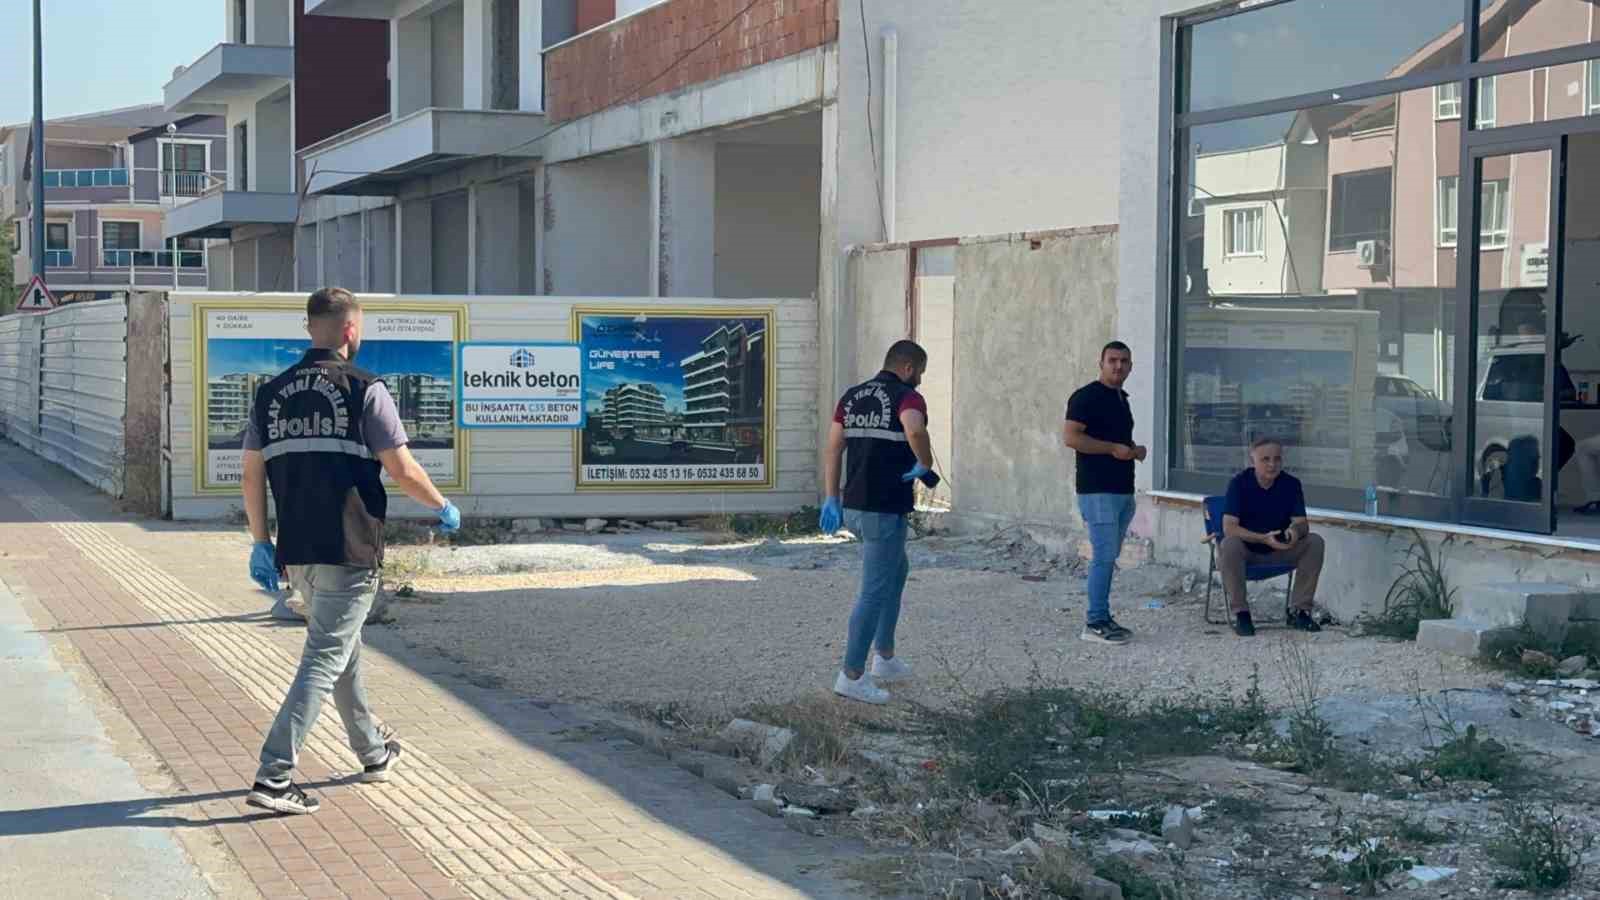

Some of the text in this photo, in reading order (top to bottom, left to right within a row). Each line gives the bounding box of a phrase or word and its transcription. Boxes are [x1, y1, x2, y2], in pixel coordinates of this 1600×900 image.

[589, 347, 661, 361] GÜNEŞTEPE
[463, 370, 580, 388] teknik beton
[465, 403, 478, 412] BU
[480, 402, 526, 413] İNŞAATTA
[547, 403, 579, 412] BETON
[278, 411, 333, 438] POLİS
[476, 414, 569, 423] KULLANILMAKTADIR
[848, 411, 881, 427] POLİS
[587, 467, 628, 480] İLETİŞİM:
[630, 468, 651, 479] 0532
[652, 468, 668, 479] 435
[670, 468, 680, 479] 13
[697, 468, 718, 479] 0532
[719, 467, 735, 479] 435
[749, 467, 760, 478] 50
